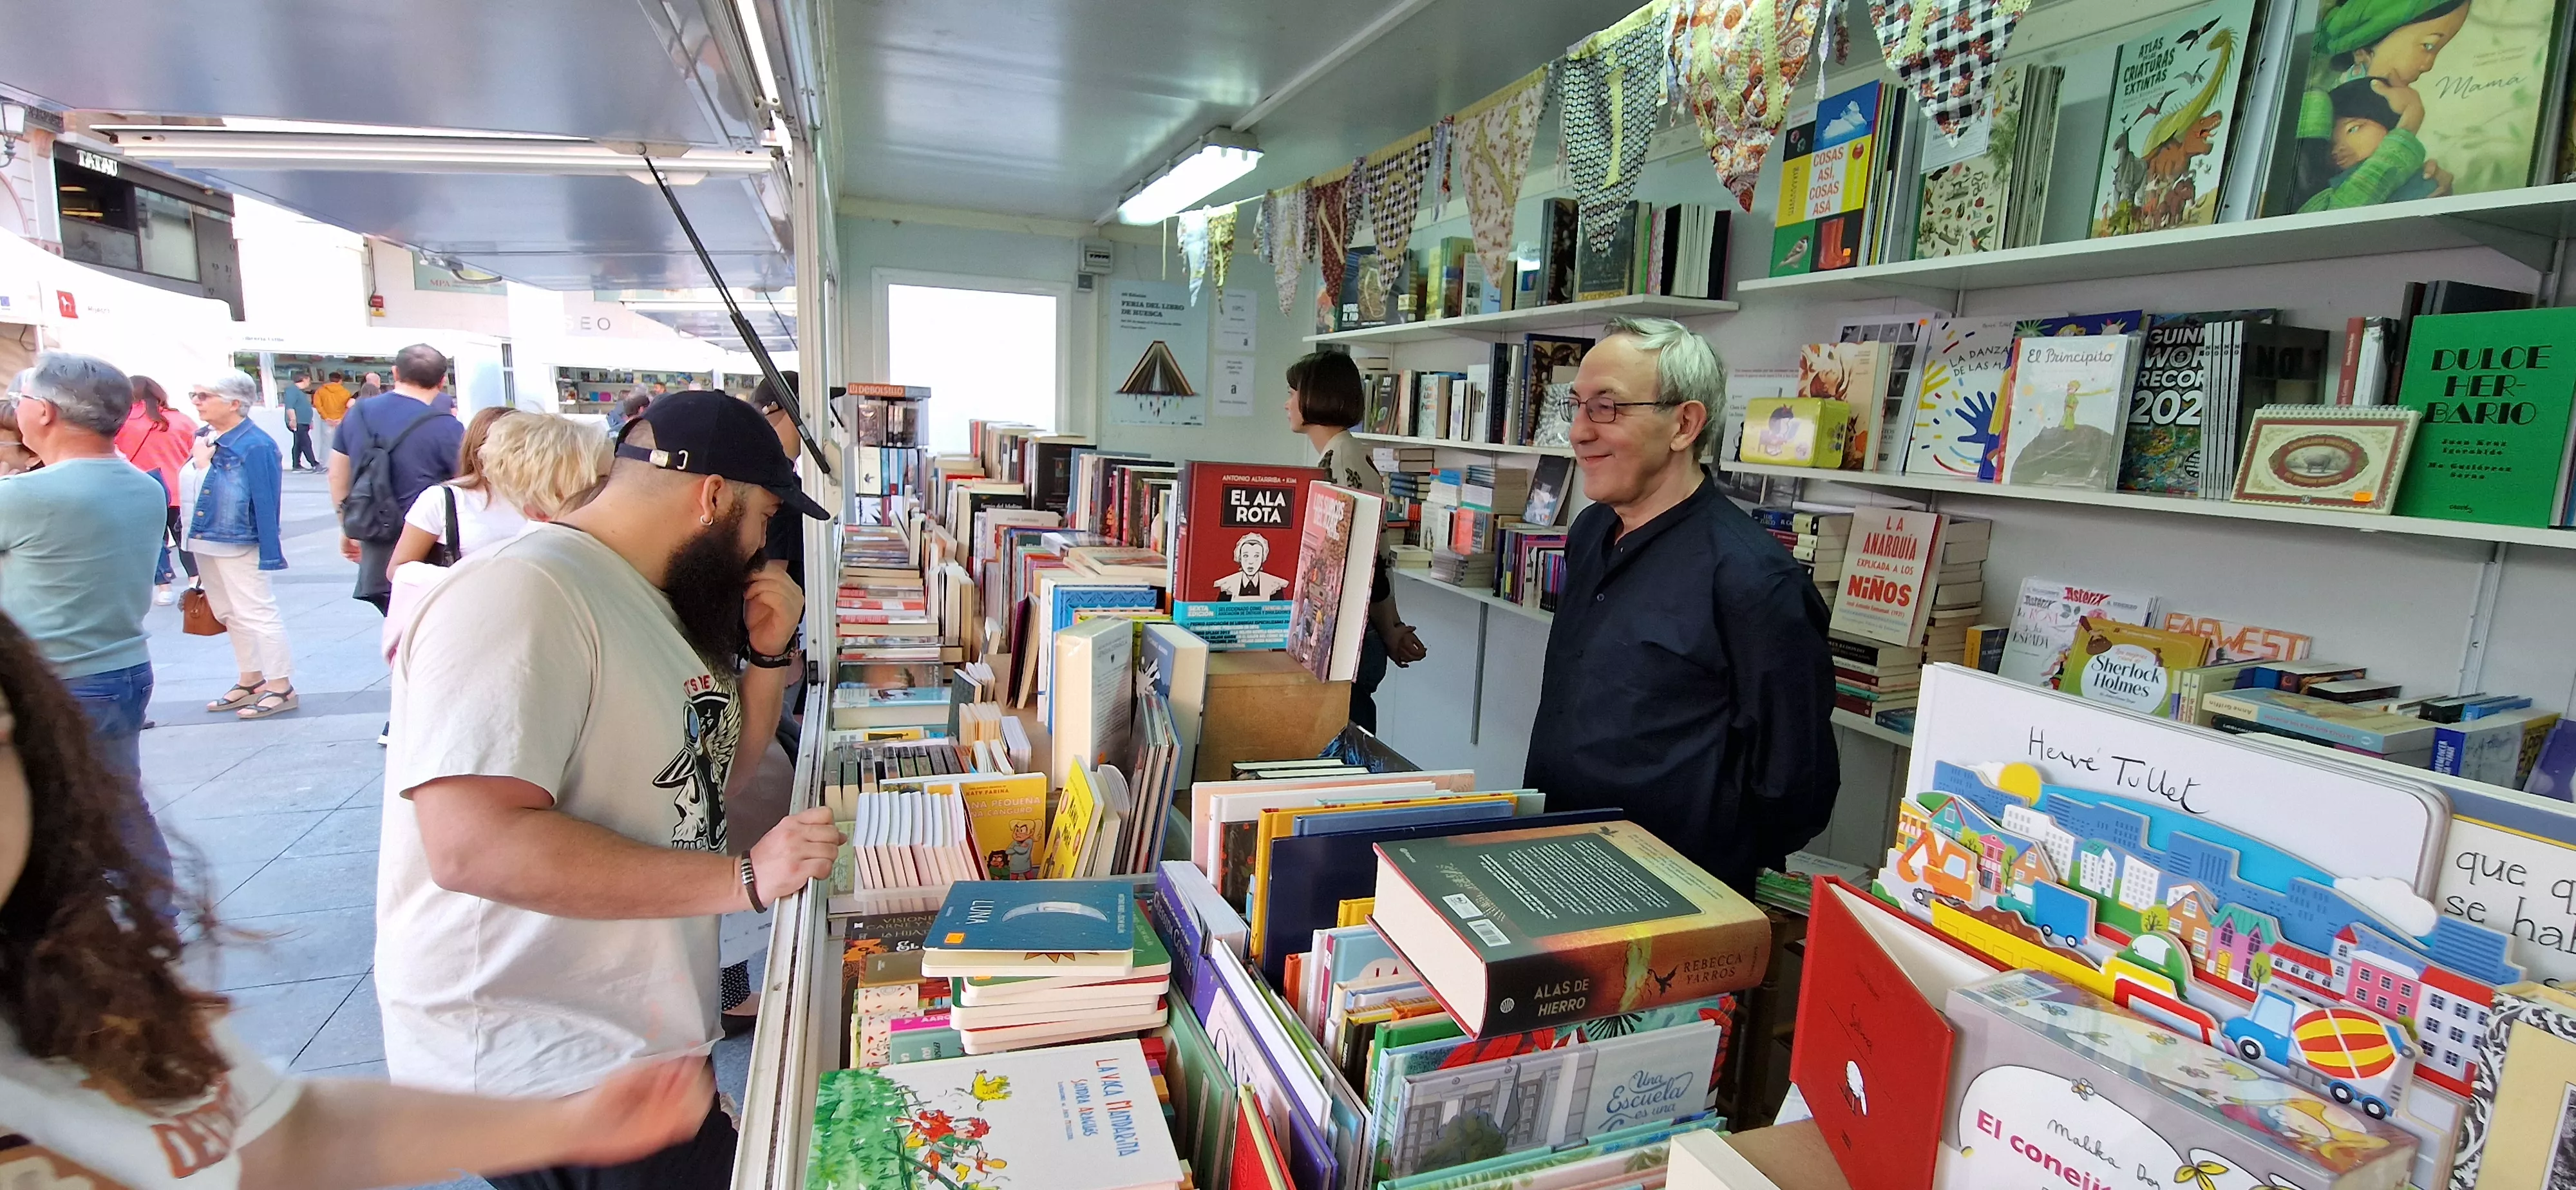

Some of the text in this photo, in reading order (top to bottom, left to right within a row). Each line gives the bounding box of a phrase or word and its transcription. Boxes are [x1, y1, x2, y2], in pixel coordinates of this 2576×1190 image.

[2138, 36, 2164, 59] ATLAS
[2124, 47, 2175, 83] CRIATURAS
[2125, 68, 2167, 96] EXTINTAS
[2436, 72, 2527, 99] Mamá
[1814, 147, 1844, 167] COSAS
[1817, 163, 1835, 183] ASÍ,
[1809, 181, 1839, 200] COSAS
[1812, 199, 1831, 216] ASÁ
[1949, 346, 2009, 368] LA DANZA
[2027, 348, 2114, 366] El Principito
[2431, 345, 2553, 371] DULCE
[1954, 366, 1965, 377] DE
[1969, 361, 1989, 372] LAS
[858, 385, 903, 395] DEBOLSILLO
[2444, 374, 2526, 397] HER-
[2423, 402, 2537, 425] BARIO
[1231, 489, 1286, 507] EL ALA
[1236, 506, 1282, 523] ROTA
[1886, 516, 1903, 532] LA
[1862, 533, 1917, 561] ANARQUÍA
[1857, 558, 1914, 575] EXPLICADA A LOS
[2023, 594, 2058, 609] Astérix
[2063, 587, 2112, 606] Astérix
[2091, 654, 2161, 685] Sherlock
[2094, 672, 2150, 697] Holmes
[2208, 700, 2252, 715] Anne Griffin
[2029, 726, 2210, 814] Hervé Tullet
[987, 806, 1032, 817] CANGURO
[2456, 851, 2527, 887] que
[965, 900, 994, 924] LUNA
[1153, 891, 1173, 939] CRESSIDA
[2444, 895, 2486, 924] se
[1173, 929, 1192, 976] COWELL
[1683, 953, 1744, 973] REBECCA
[1687, 967, 1736, 985] YARROS
[1534, 978, 1591, 999] ALAS DE
[1538, 997, 1586, 1017] HIERRO
[1095, 1058, 1125, 1097] LA VACA
[1631, 1070, 1665, 1090] Una
[1070, 1079, 1091, 1104] SANDRA
[1606, 1073, 1689, 1113] Escuela
[1633, 1103, 1676, 1120] es una
[1976, 1109, 2002, 1140] El
[2047, 1119, 2122, 1169] Malika
